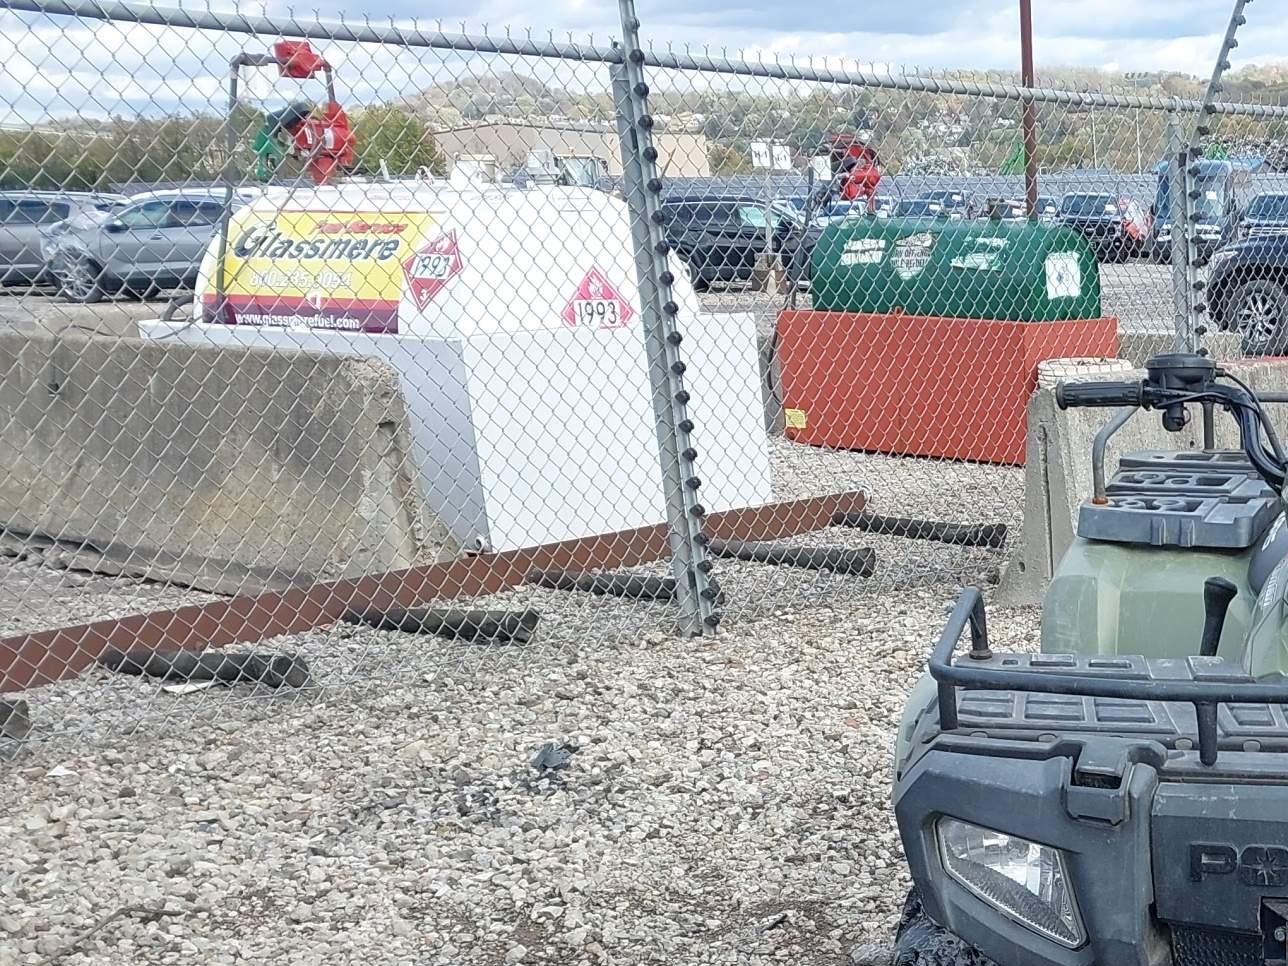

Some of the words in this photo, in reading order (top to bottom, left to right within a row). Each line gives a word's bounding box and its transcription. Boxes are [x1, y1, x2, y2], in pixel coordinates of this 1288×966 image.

[234, 221, 400, 261] Glassmere
[412, 255, 451, 278] 1993
[420, 288, 431, 301] 3
[578, 301, 617, 324] 1993
